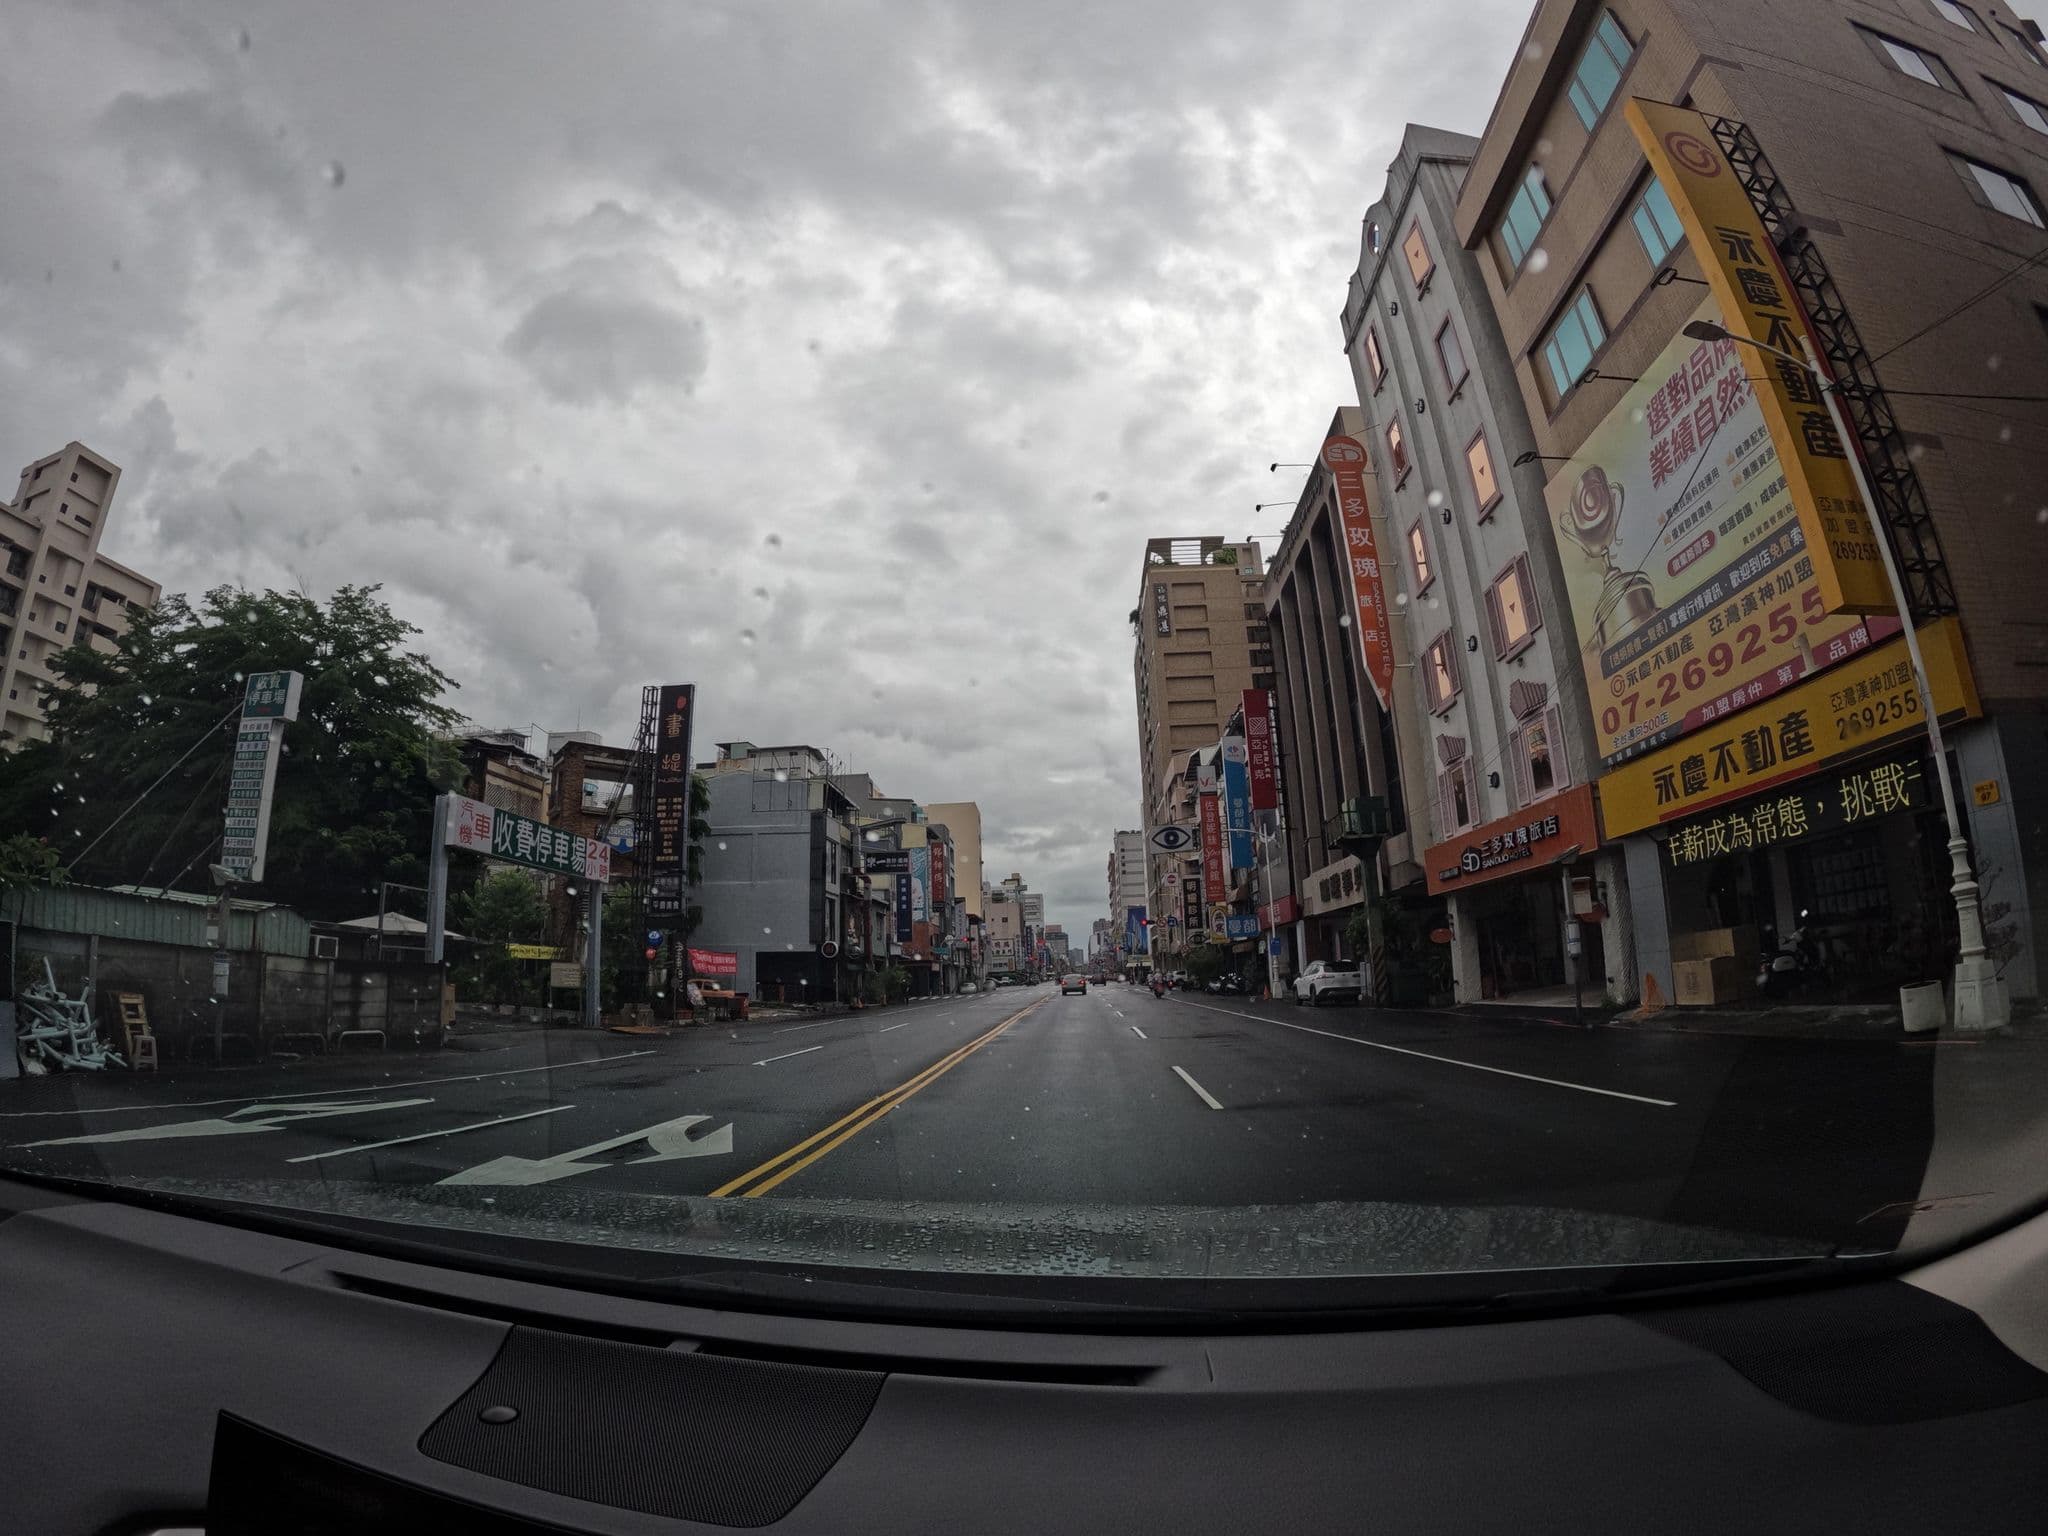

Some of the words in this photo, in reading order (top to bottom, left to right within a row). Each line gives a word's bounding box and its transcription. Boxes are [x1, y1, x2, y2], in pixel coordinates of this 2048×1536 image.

[1713, 225, 1848, 461] 永慶不動產
[1649, 362, 1757, 490] 業績自然
[1338, 470, 1380, 643] 三多玫瑰旅店
[1626, 632, 1696, 688] 永慶不動產
[1829, 627, 1872, 663] 品牌
[1829, 659, 1915, 713] 亞灣漢神加盟
[1251, 738, 1265, 780] 亞尼克
[1653, 709, 1815, 806] 永慶不動產
[494, 812, 586, 873] 收費停車場
[588, 841, 608, 863] 24
[1480, 815, 1560, 858] 三多玫瑰旅店
[587, 864, 608, 879] 小時
[1228, 918, 1257, 934] 曼都
